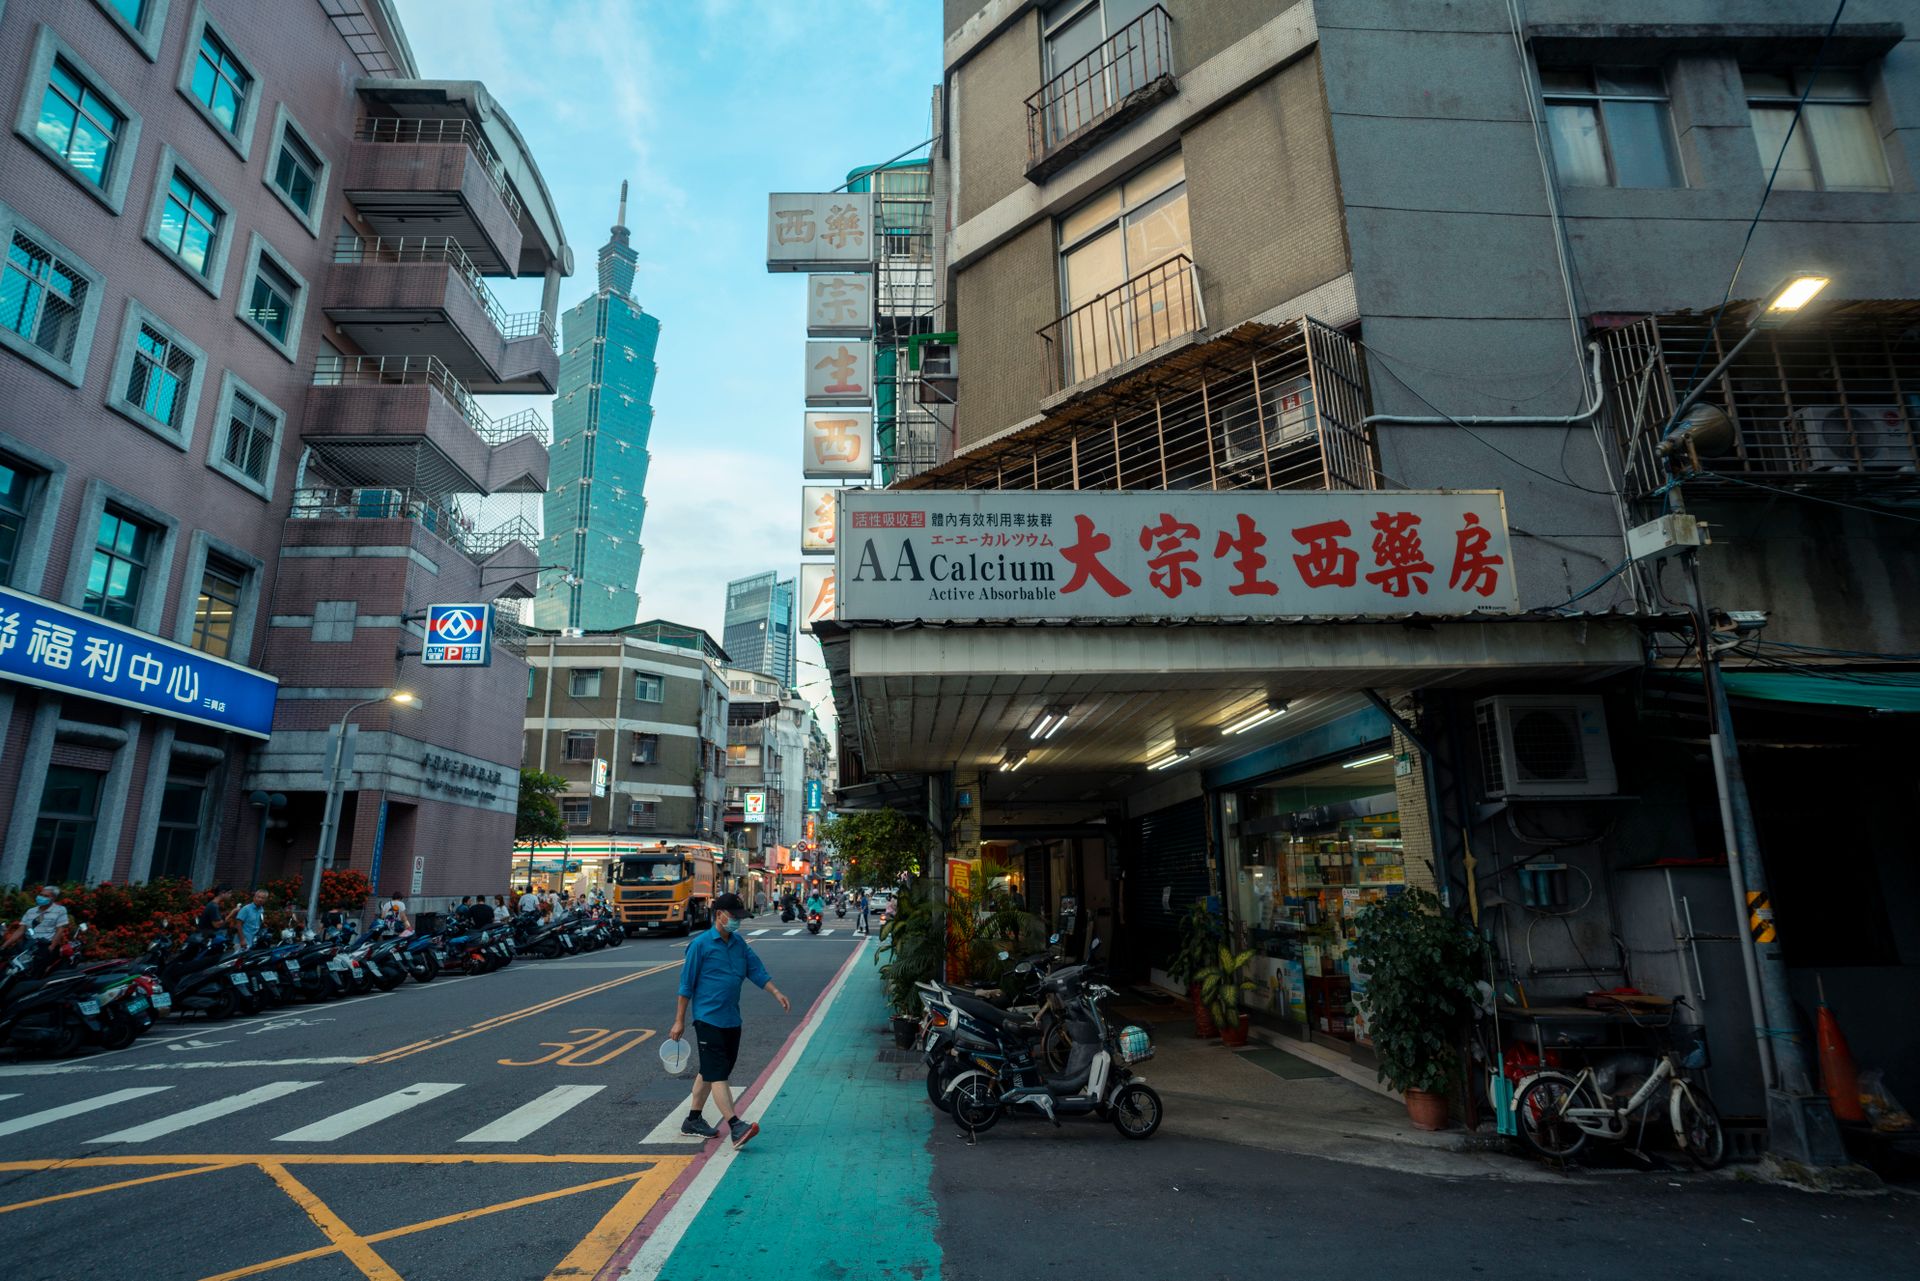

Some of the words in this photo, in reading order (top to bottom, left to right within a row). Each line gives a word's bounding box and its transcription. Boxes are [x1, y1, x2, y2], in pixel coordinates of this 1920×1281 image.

[775, 203, 865, 249] 西藥
[855, 512, 923, 527] 活性吸收型
[853, 538, 924, 582] AA
[929, 553, 1055, 582] Calcium
[1058, 512, 1504, 599] 大宗生西藥房
[929, 587, 975, 600] Active
[979, 586, 1056, 600] Absorbable
[447, 647, 459, 660] P
[497, 1028, 656, 1067] 30
